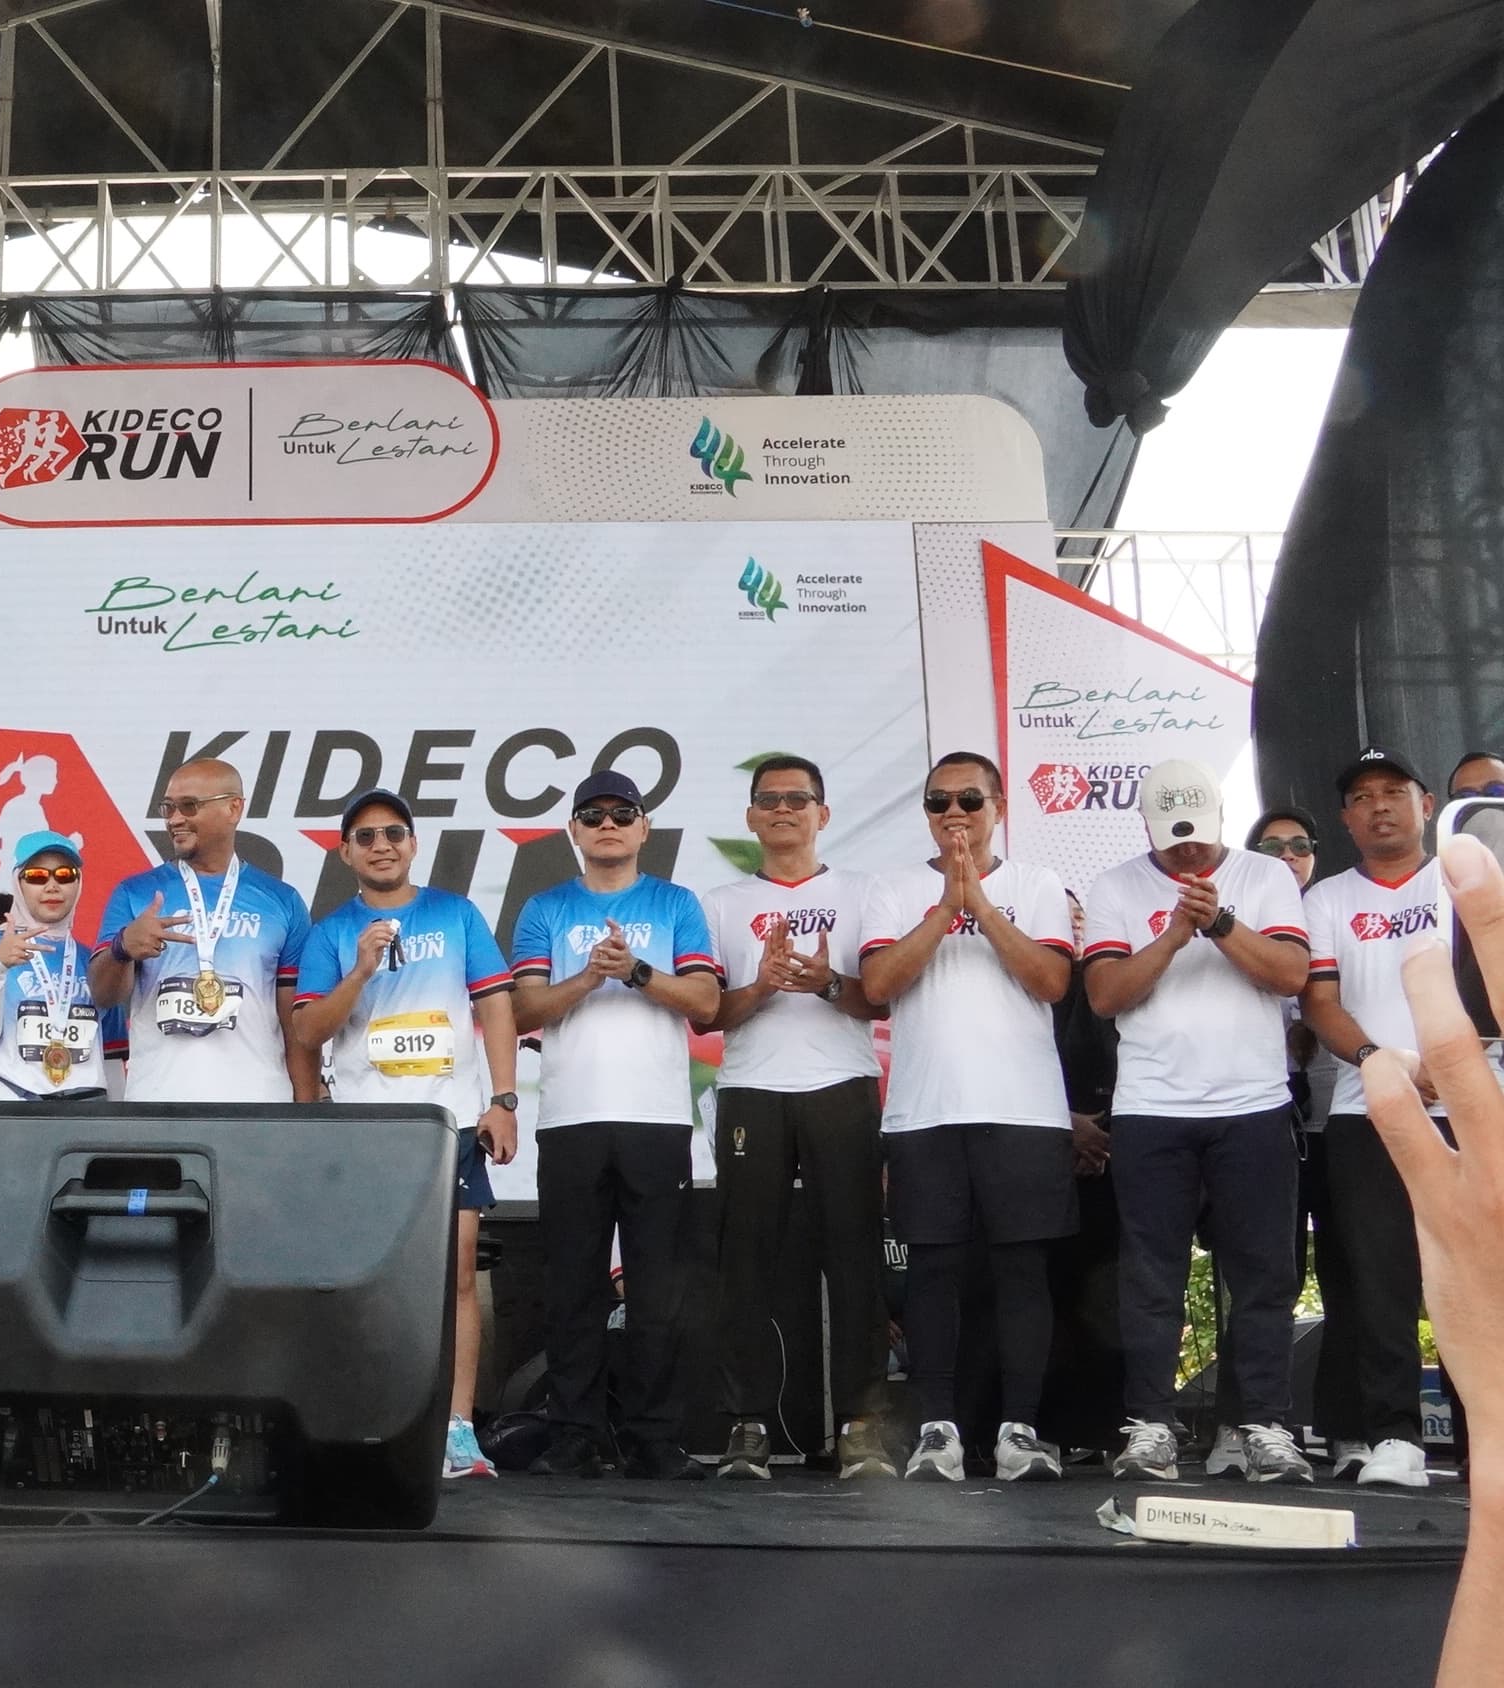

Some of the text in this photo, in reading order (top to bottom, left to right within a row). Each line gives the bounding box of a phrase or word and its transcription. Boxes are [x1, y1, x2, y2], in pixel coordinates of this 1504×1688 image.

[81, 407, 223, 433] KIDECO
[278, 409, 464, 438] Berlari
[283, 435, 480, 465] Untuk Lestari
[762, 437, 846, 450] Accelerate
[65, 432, 223, 481] RUN
[763, 454, 826, 470] Through
[764, 472, 851, 485] Innovation
[796, 574, 863, 584] Accelerate
[84, 570, 342, 613] Berlari
[796, 588, 847, 601] Through
[798, 603, 867, 613] Innovation
[97, 610, 360, 651] Untuk Lestari
[1012, 677, 1207, 709] Berlari
[1019, 708, 1225, 739] Untuk Lestari
[145, 726, 684, 820] KIDECO
[1087, 765, 1151, 779] KIDEC
[1082, 781, 1141, 810] RU
[786, 908, 837, 920] KIDECO
[787, 917, 837, 936] RUN
[393, 1034, 436, 1053] 8119
[1146, 1508, 1206, 1526] DIMENSI
